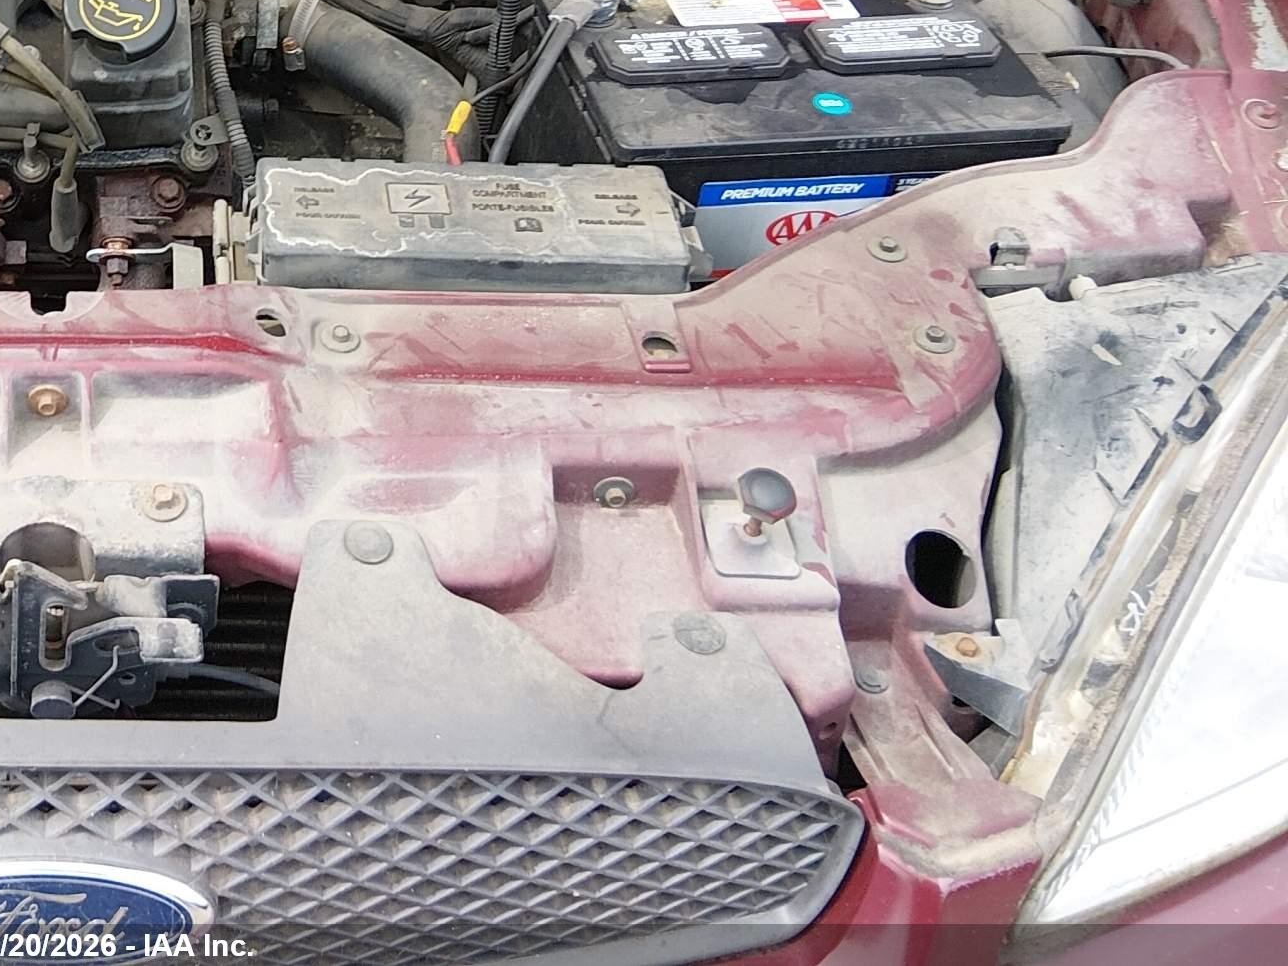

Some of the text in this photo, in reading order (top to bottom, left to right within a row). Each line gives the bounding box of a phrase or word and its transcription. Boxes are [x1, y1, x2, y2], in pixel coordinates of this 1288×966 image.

[472, 189, 547, 199] COMPARTMENT
[721, 183, 865, 201] PREMIUM BATTERY
